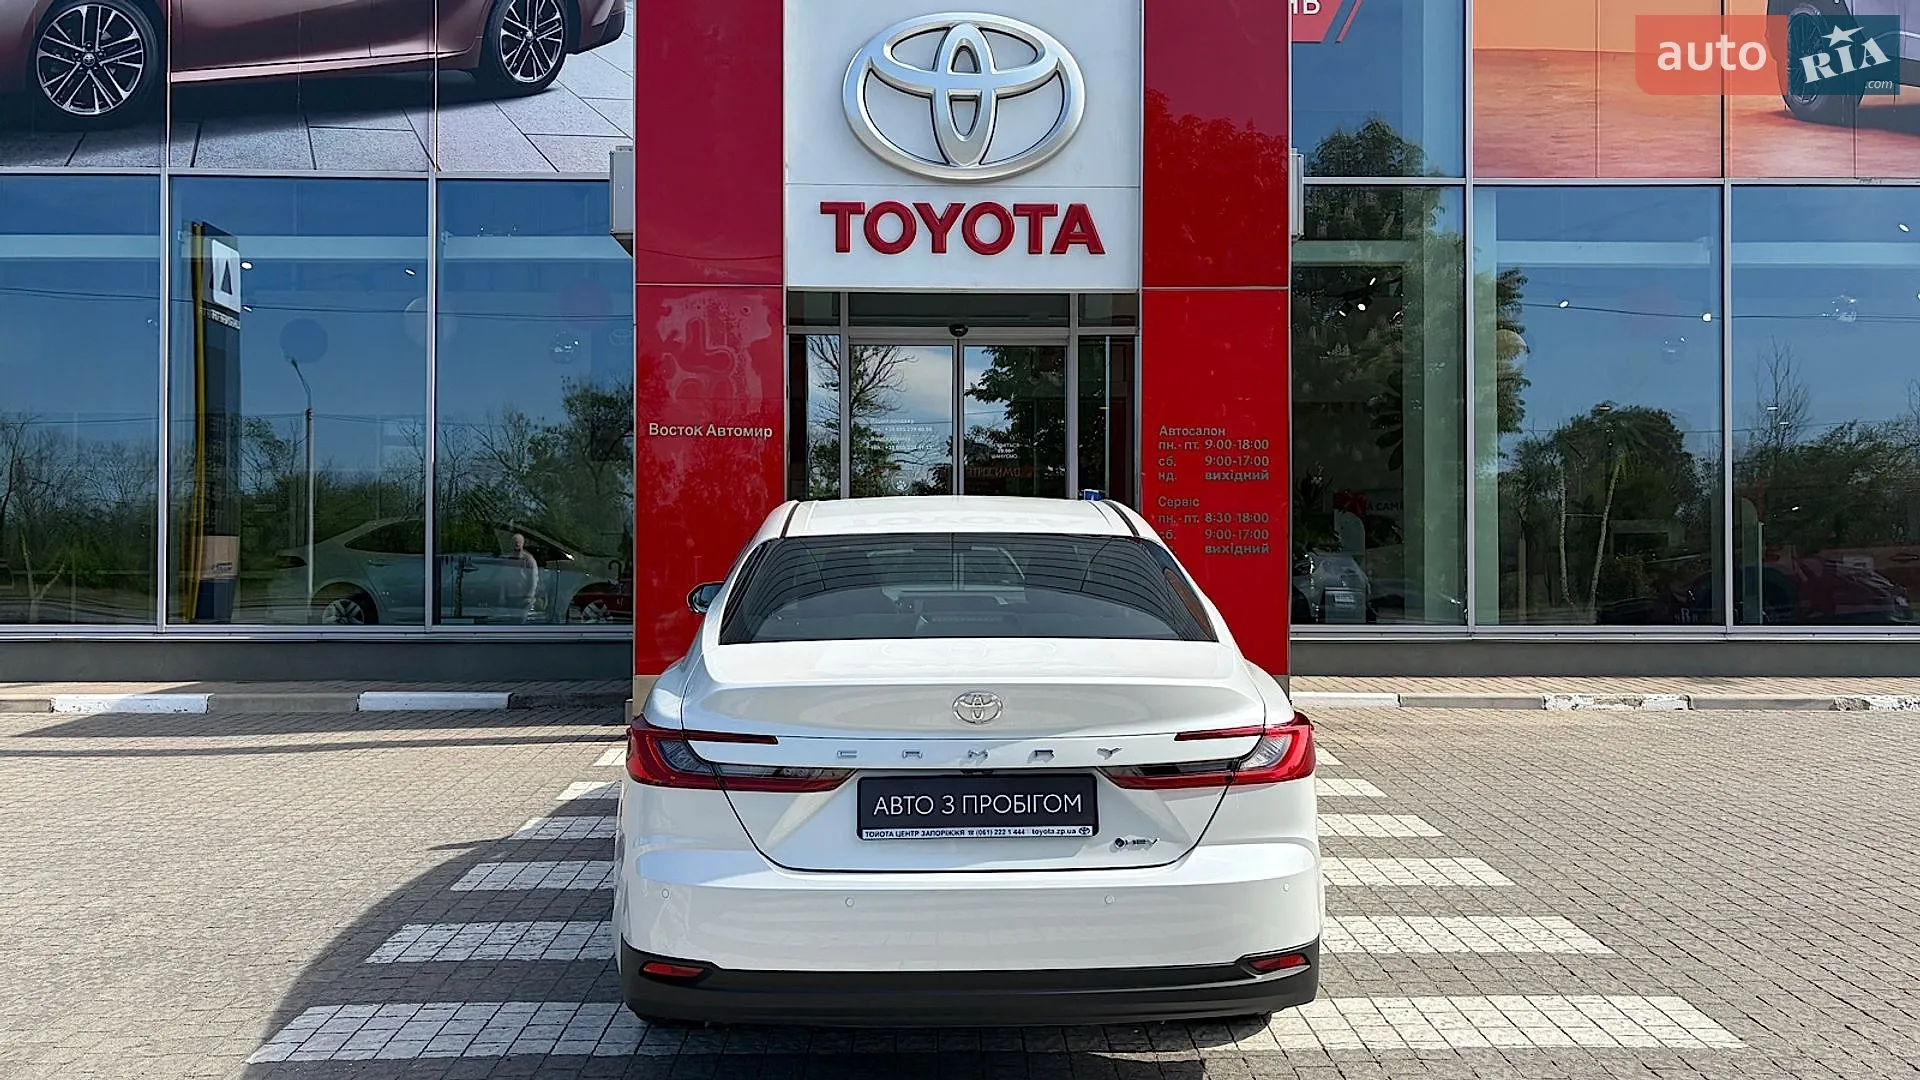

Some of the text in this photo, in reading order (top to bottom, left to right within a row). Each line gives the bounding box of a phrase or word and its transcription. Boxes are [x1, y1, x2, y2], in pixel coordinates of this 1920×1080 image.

[819, 201, 1106, 256] TOYOTA
[648, 422, 773, 440] Восток Автомир
[1159, 425, 1226, 436] Автосалон
[1158, 457, 1177, 467] сб.
[1158, 469, 1270, 482] нд. вихідний
[1158, 496, 1200, 509] Сервіс
[1204, 543, 1270, 556] вихідний
[836, 748, 1123, 762] CAMRY
[873, 796, 934, 815] АВТО
[961, 793, 1083, 815] ПРОБІГОМ
[864, 830, 894, 838] ТОЙОТА
[895, 830, 919, 838] ЦЕНТР
[921, 829, 966, 838] ЗАПОРІЖЖЯ
[976, 829, 993, 838] (061)
[1031, 828, 1077, 838] toyota.zp.ua
